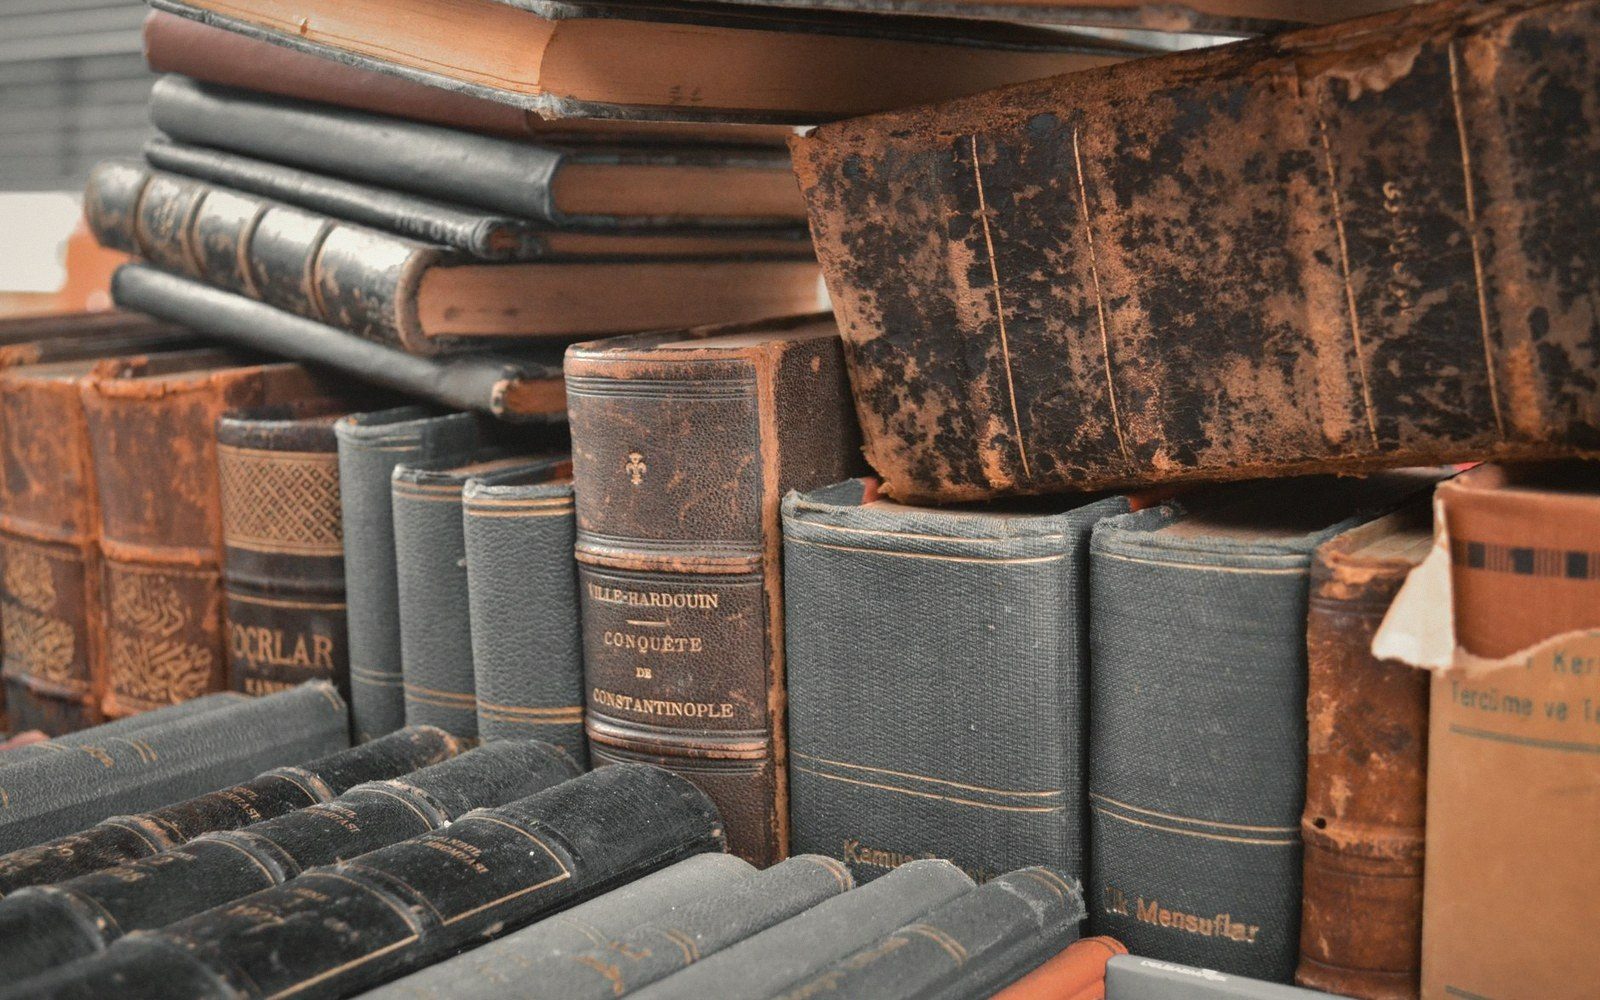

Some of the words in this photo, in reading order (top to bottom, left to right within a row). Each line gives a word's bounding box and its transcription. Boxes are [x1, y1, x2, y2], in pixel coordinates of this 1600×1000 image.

[587, 581, 719, 609] VILLE-HARDOUIN
[604, 631, 703, 654] CONQUÊTE
[636, 667, 652, 679] DE
[592, 687, 734, 718] CONSTANTINOPLE
[1545, 700, 1568, 721] ve
